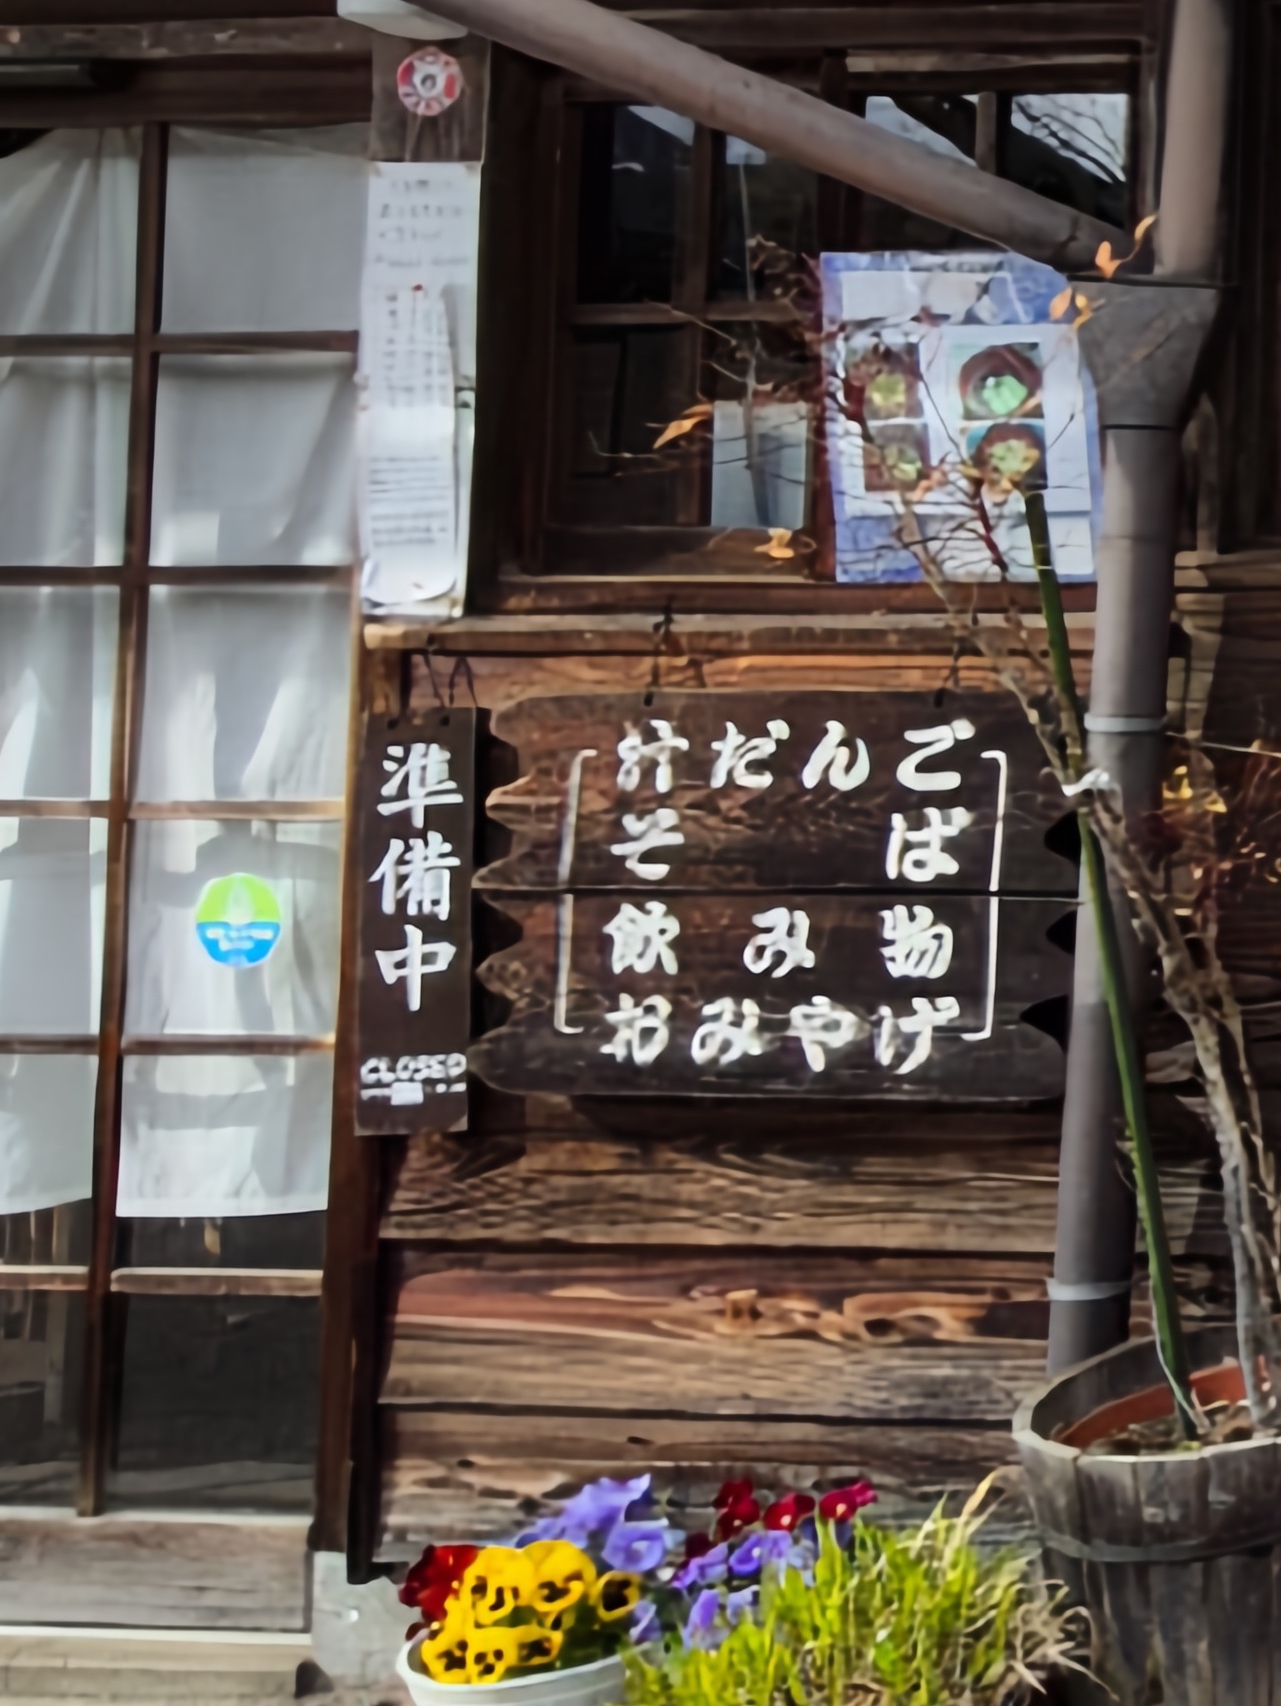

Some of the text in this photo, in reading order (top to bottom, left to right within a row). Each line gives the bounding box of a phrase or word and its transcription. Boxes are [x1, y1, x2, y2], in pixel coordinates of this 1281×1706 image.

[615, 717, 977, 794] 汁だんご
[367, 741, 465, 1013] 準備中
[609, 806, 976, 883] そば
[601, 900, 954, 980] 飲み物
[360, 1052, 468, 1085] CLOSED
[599, 993, 962, 1076] おみやげ
